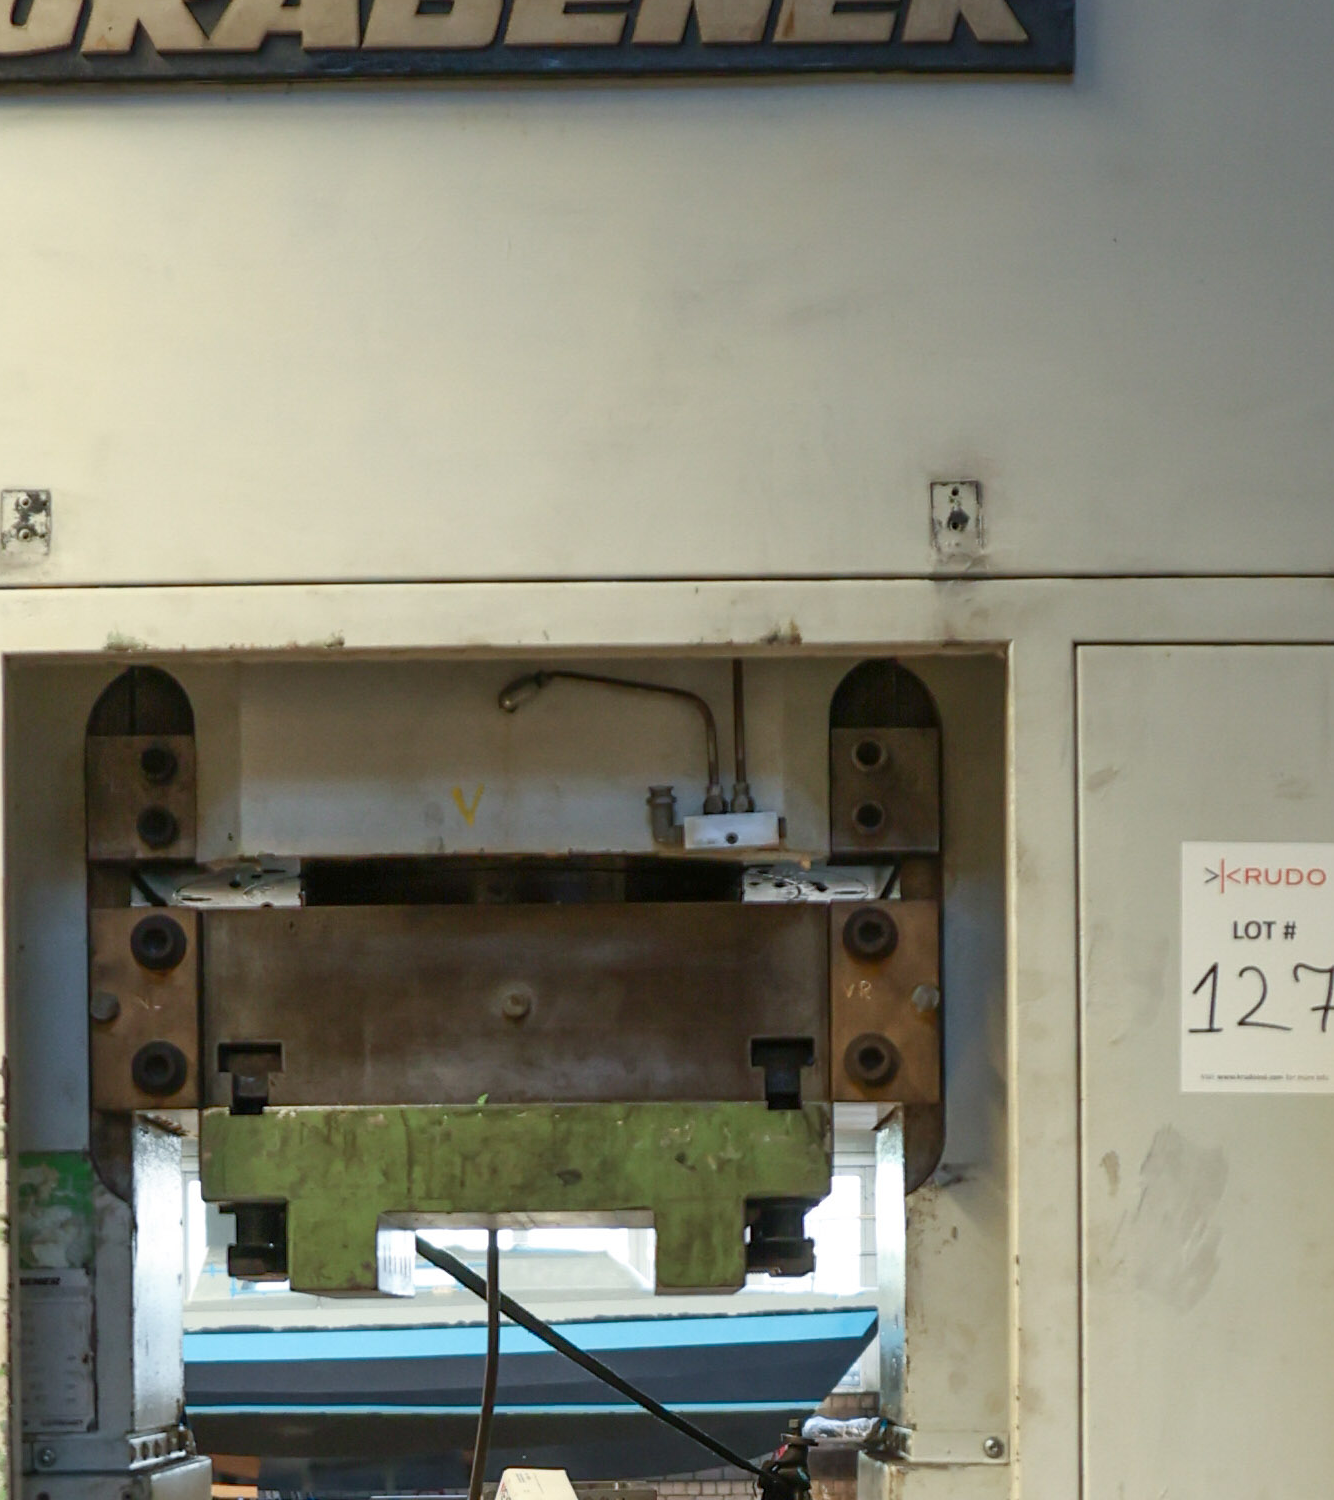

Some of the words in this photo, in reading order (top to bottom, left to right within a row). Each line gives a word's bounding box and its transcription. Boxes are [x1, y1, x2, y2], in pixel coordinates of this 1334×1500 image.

[1220, 858, 1327, 894] KRUDO
[1233, 920, 1276, 940] LOT
[1283, 921, 1297, 940] #
